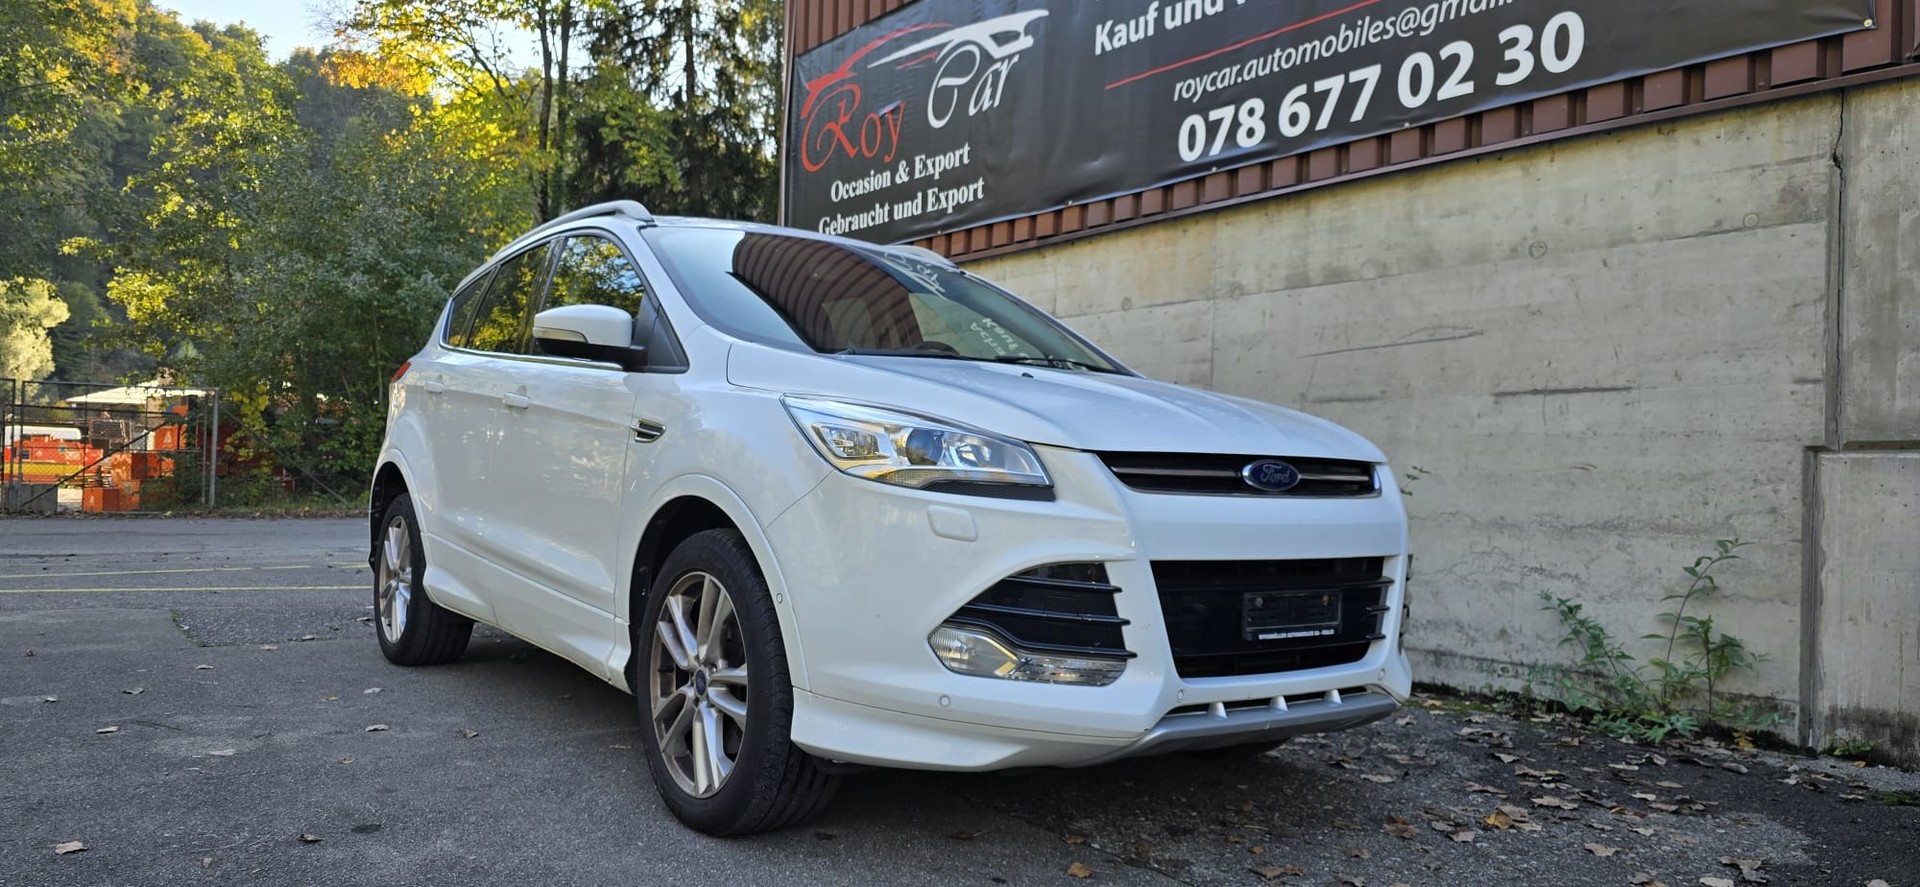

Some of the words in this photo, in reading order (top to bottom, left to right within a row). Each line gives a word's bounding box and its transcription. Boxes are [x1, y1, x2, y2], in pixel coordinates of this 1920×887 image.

[1095, 1, 1158, 55] Kauf
[1173, 0, 1512, 104] roycar.automobiles@gma.
[801, 84, 906, 172] Roy
[928, 41, 1019, 128] Car
[1177, 98, 1266, 163] 078
[1278, 64, 1382, 138] 677
[1398, 40, 1474, 109] 02
[1495, 11, 1585, 86] 30
[831, 170, 891, 202] Occasion
[895, 160, 910, 184] &
[914, 142, 970, 179] Export
[819, 202, 890, 235] Gebraucht
[893, 192, 922, 218] und
[926, 177, 985, 213] Export
[1261, 463, 1291, 484] Ford
